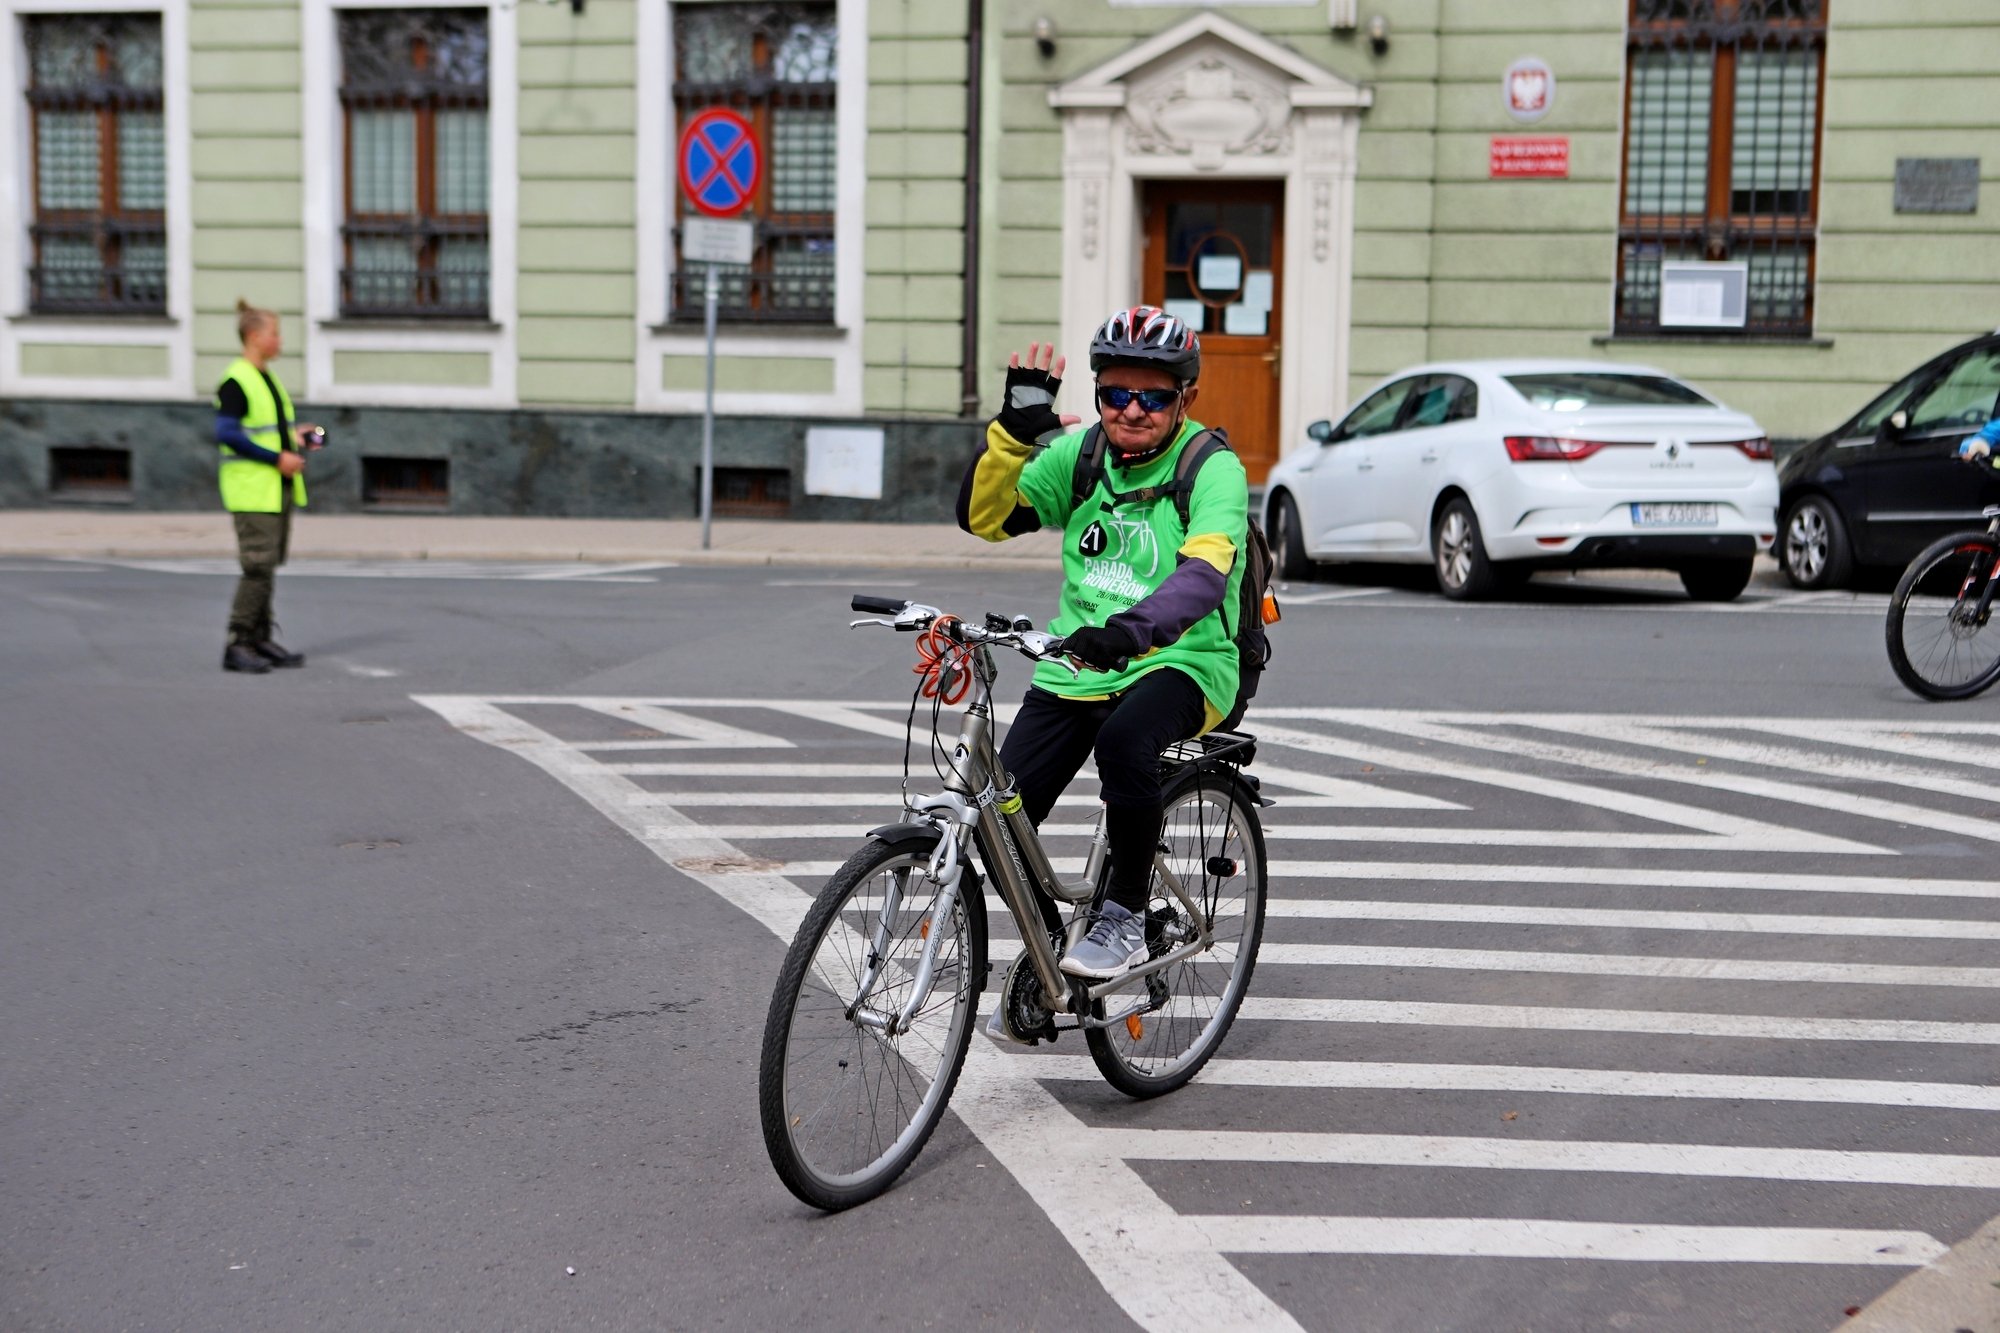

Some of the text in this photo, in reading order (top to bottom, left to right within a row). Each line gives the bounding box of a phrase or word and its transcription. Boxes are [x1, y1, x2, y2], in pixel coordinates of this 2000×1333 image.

[1080, 524, 1100, 551] 21
[1084, 557, 1134, 582] PARADA
[1081, 573, 1148, 599] ROWERÓW
